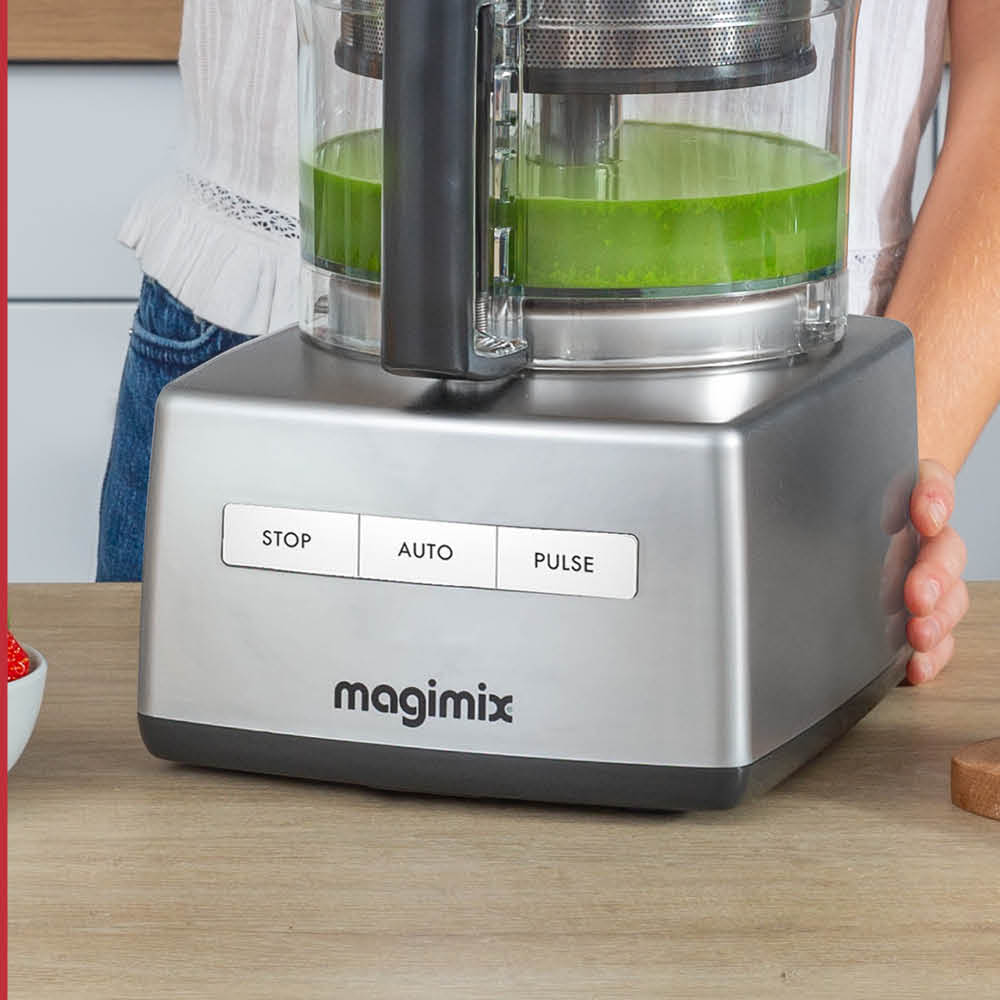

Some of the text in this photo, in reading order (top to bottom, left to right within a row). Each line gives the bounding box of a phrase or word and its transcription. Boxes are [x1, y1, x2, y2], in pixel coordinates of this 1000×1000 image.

[262, 529, 594, 573] STOP AUTO PULSE
[334, 678, 513, 728] magimix
